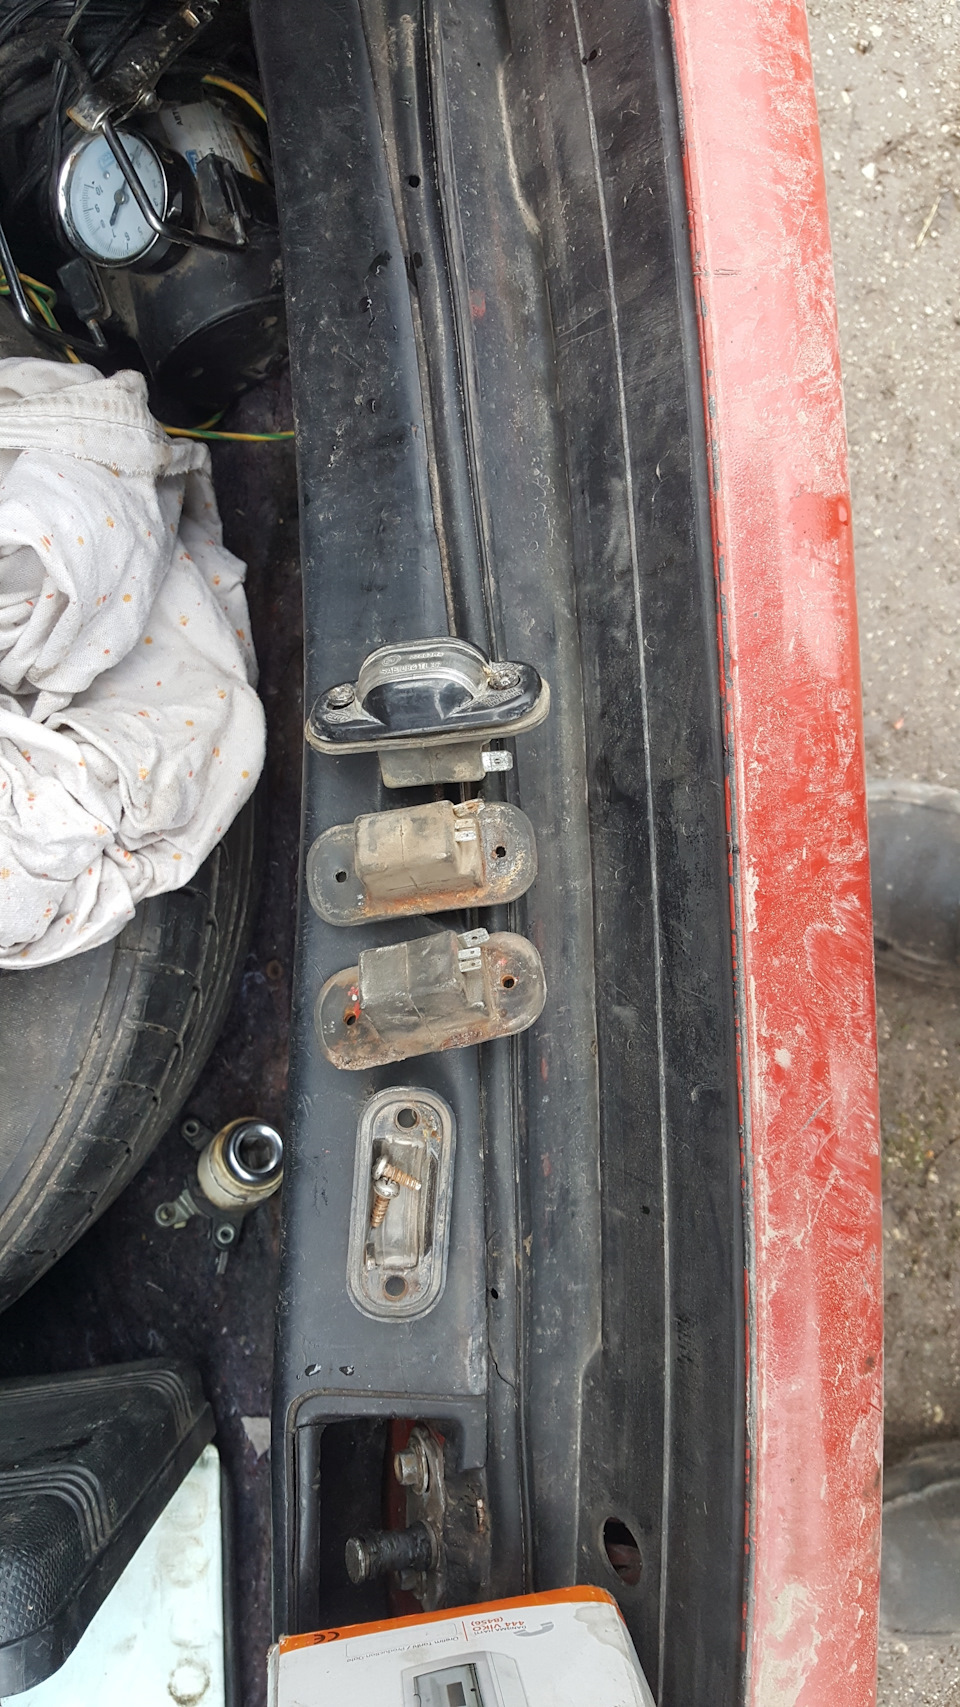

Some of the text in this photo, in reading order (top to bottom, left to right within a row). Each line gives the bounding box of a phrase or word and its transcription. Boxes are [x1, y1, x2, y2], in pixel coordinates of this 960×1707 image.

[95, 185, 104, 197] 10
[94, 203, 101, 214] 9
[124, 231, 131, 242] 6
[471, 1616, 503, 1627] (8456)
[365, 1647, 406, 1657] Production
